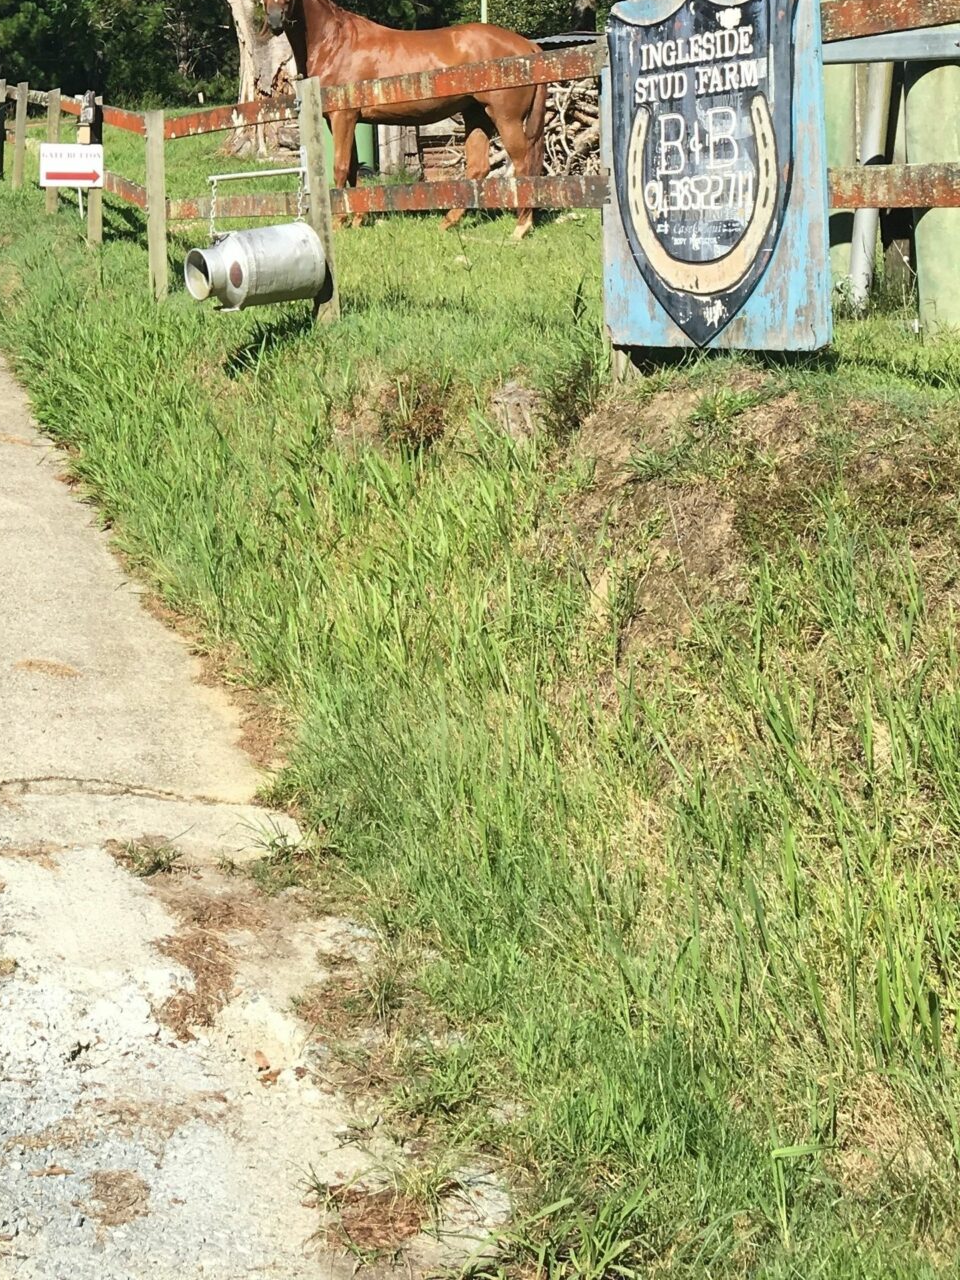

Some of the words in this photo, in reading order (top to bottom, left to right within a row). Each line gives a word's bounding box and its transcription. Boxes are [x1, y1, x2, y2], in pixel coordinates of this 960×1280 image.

[640, 24, 754, 71] INGLESIDE
[634, 72, 688, 104] STUD
[695, 59, 759, 95] FARM
[657, 113, 686, 176] B
[705, 106, 739, 170] B
